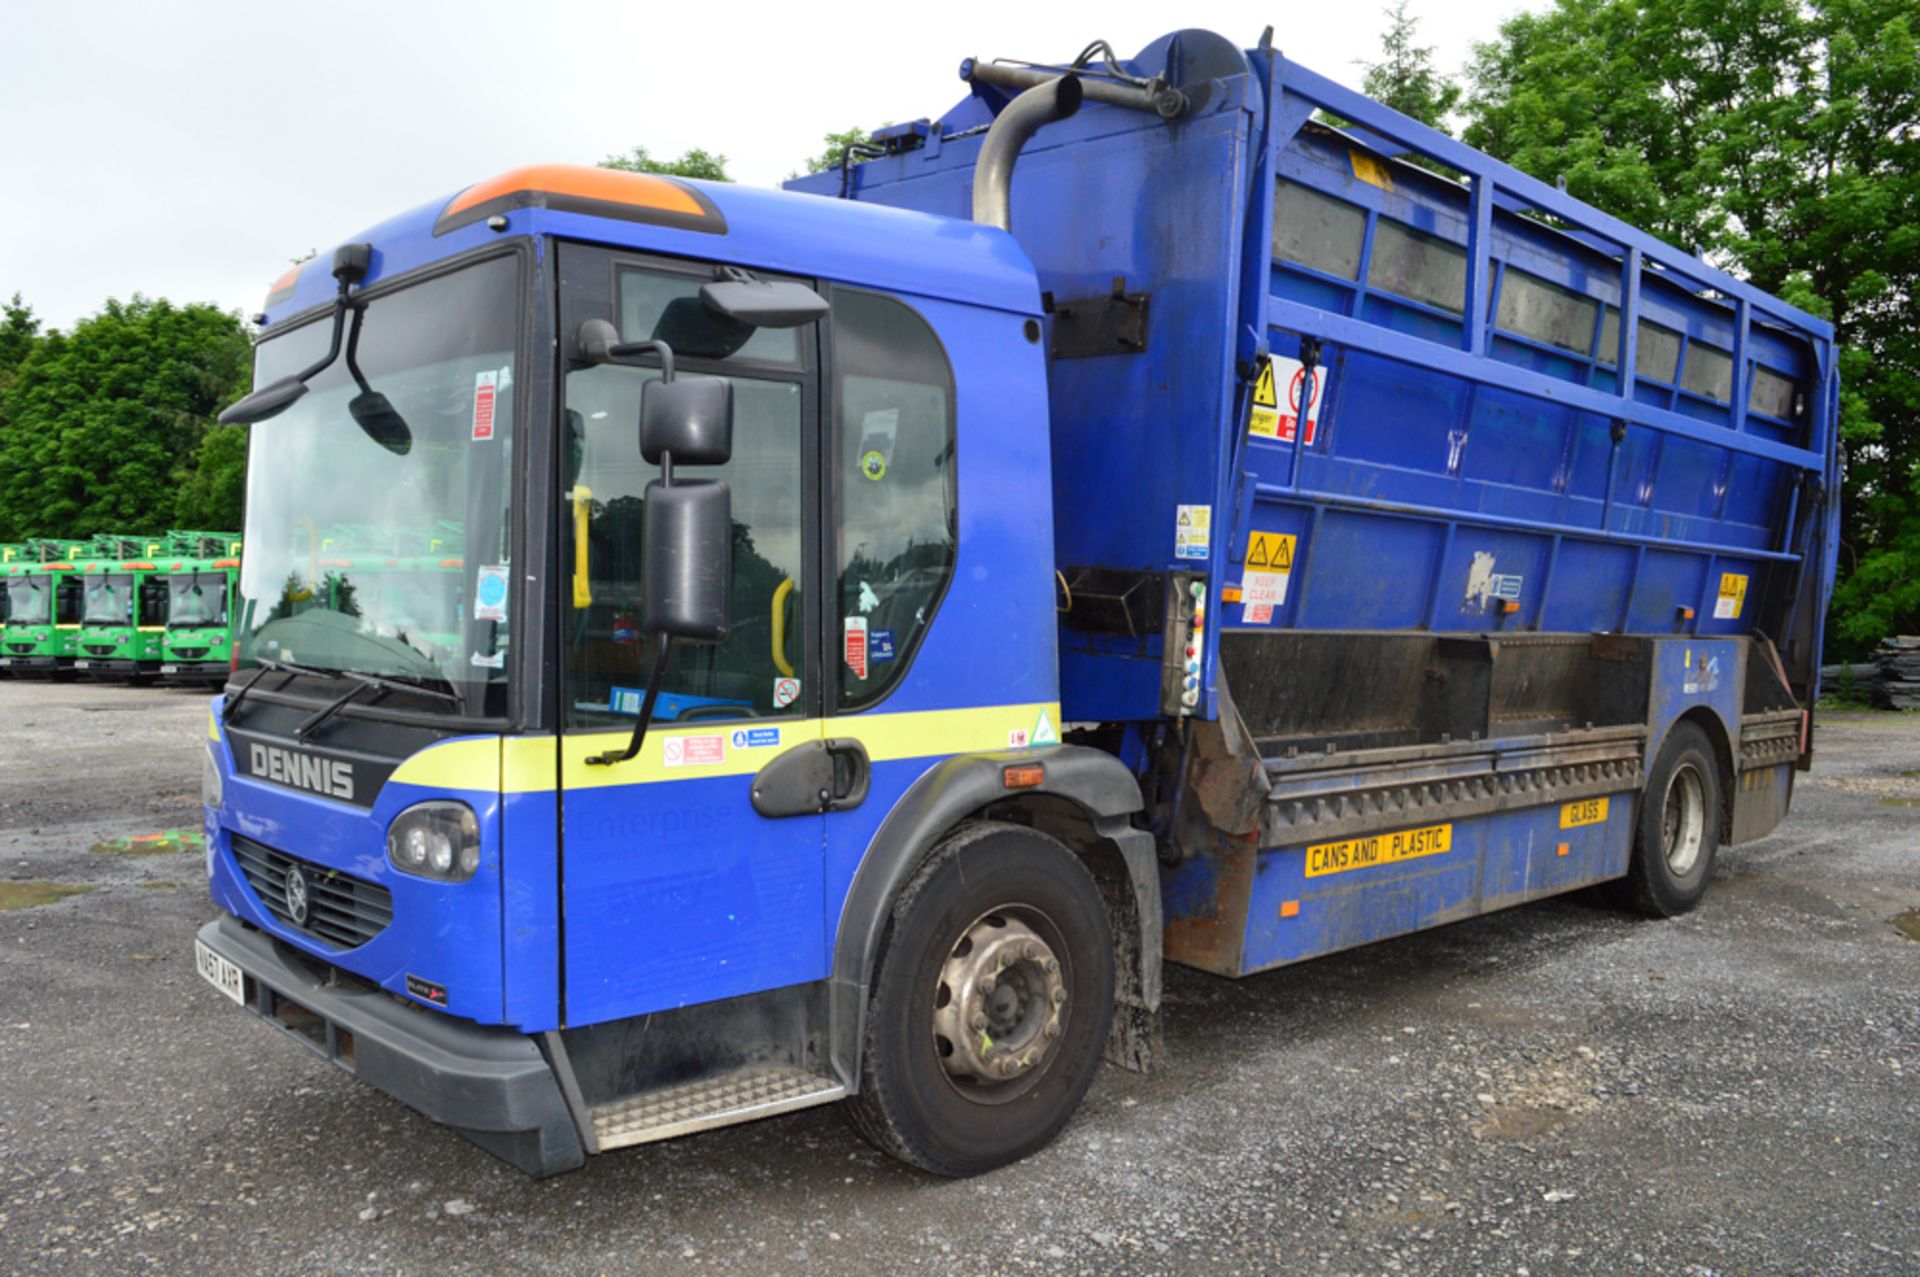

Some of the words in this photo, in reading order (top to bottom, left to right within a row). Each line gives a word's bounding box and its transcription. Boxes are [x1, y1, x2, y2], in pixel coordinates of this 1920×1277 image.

[251, 743, 353, 799] DENNIS
[578, 806, 732, 841] Enterprise
[1571, 801, 1599, 822] GLASS
[1312, 845, 1349, 871] CANS
[1352, 839, 1379, 865] AND
[1391, 828, 1443, 857] PLASTIC
